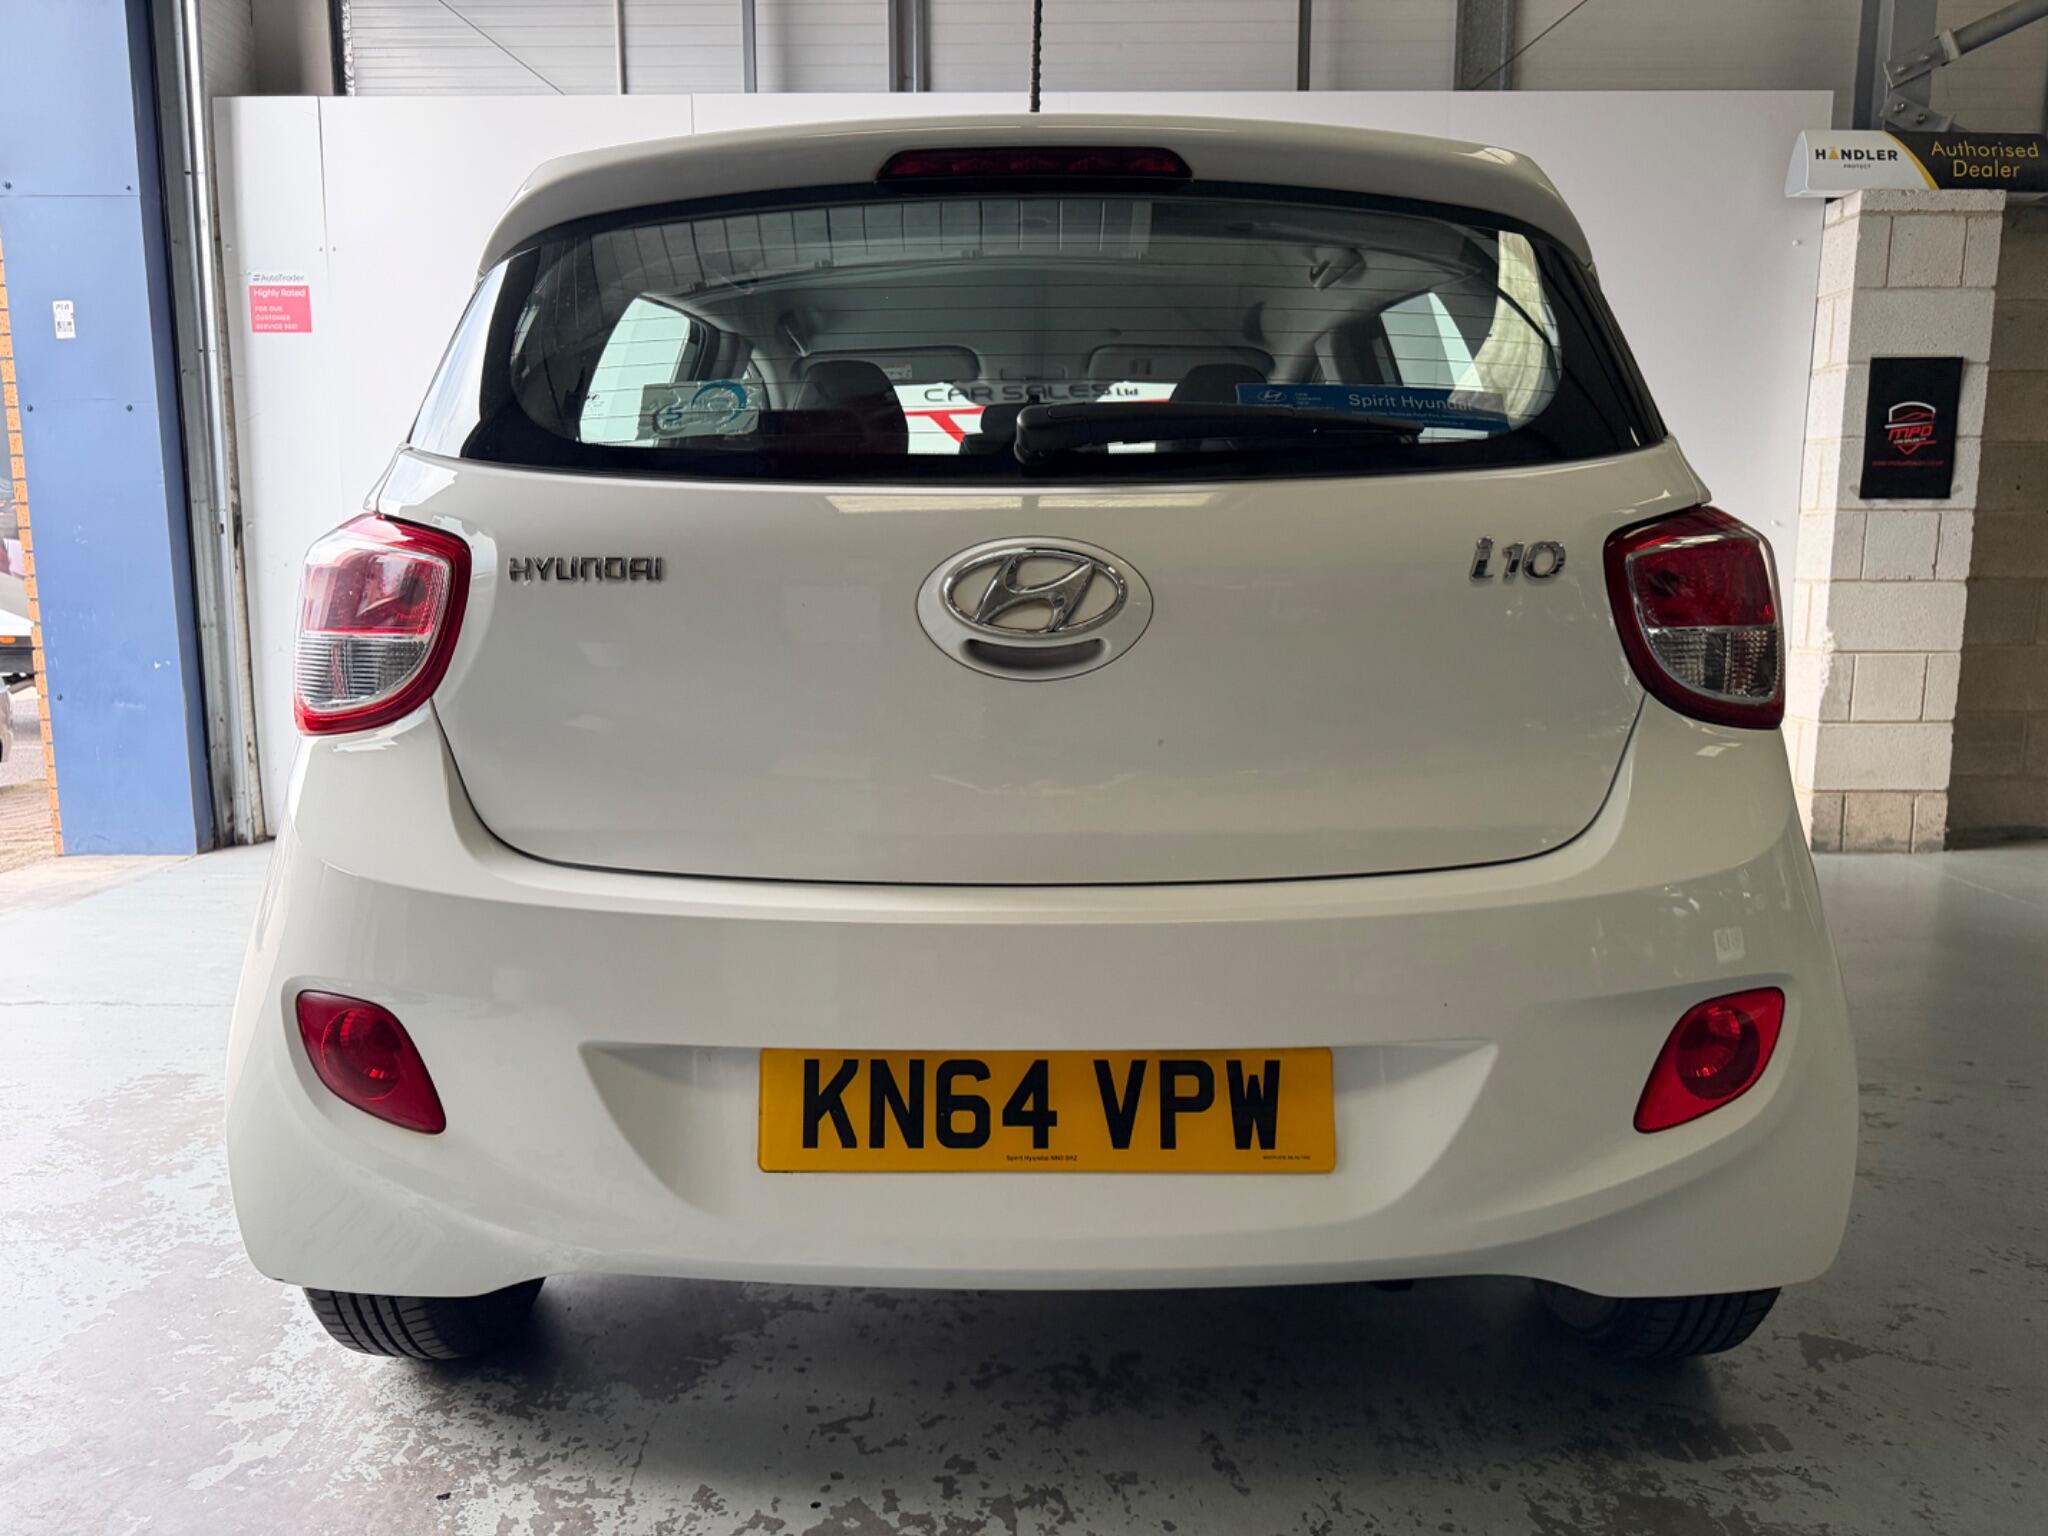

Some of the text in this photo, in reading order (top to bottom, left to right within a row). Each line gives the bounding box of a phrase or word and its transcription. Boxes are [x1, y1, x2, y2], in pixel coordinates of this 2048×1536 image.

[1815, 146, 1898, 161] HANDLER
[1931, 140, 2040, 159] Authorised
[1953, 159, 2020, 178] Dealer
[253, 287, 306, 299] Highly Rated
[924, 384, 1139, 402] CAR SALES Ltd
[1348, 393, 1473, 411] Spirit Hyundai
[508, 556, 663, 582] HYUNDAI
[802, 1058, 1282, 1150] KN64 VPW
